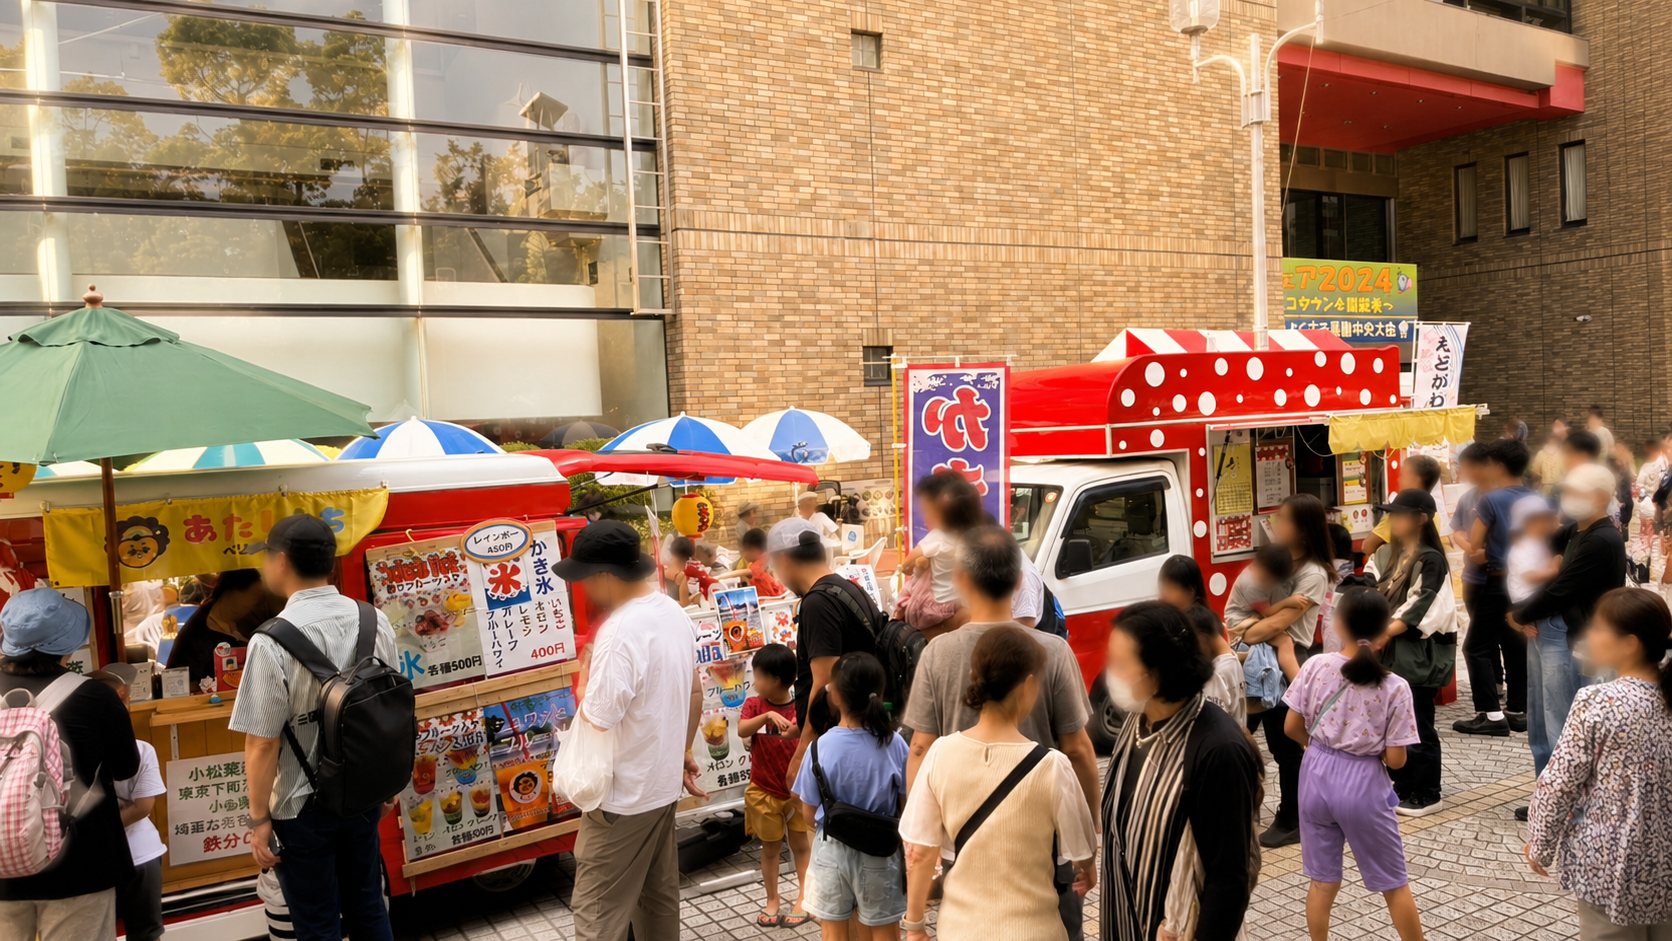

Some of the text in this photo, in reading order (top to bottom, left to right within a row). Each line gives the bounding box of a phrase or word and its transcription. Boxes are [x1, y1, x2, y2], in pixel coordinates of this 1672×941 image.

[488, 563, 521, 595] 氷
[529, 540, 554, 595] かき氷
[531, 642, 565, 659] 400円
